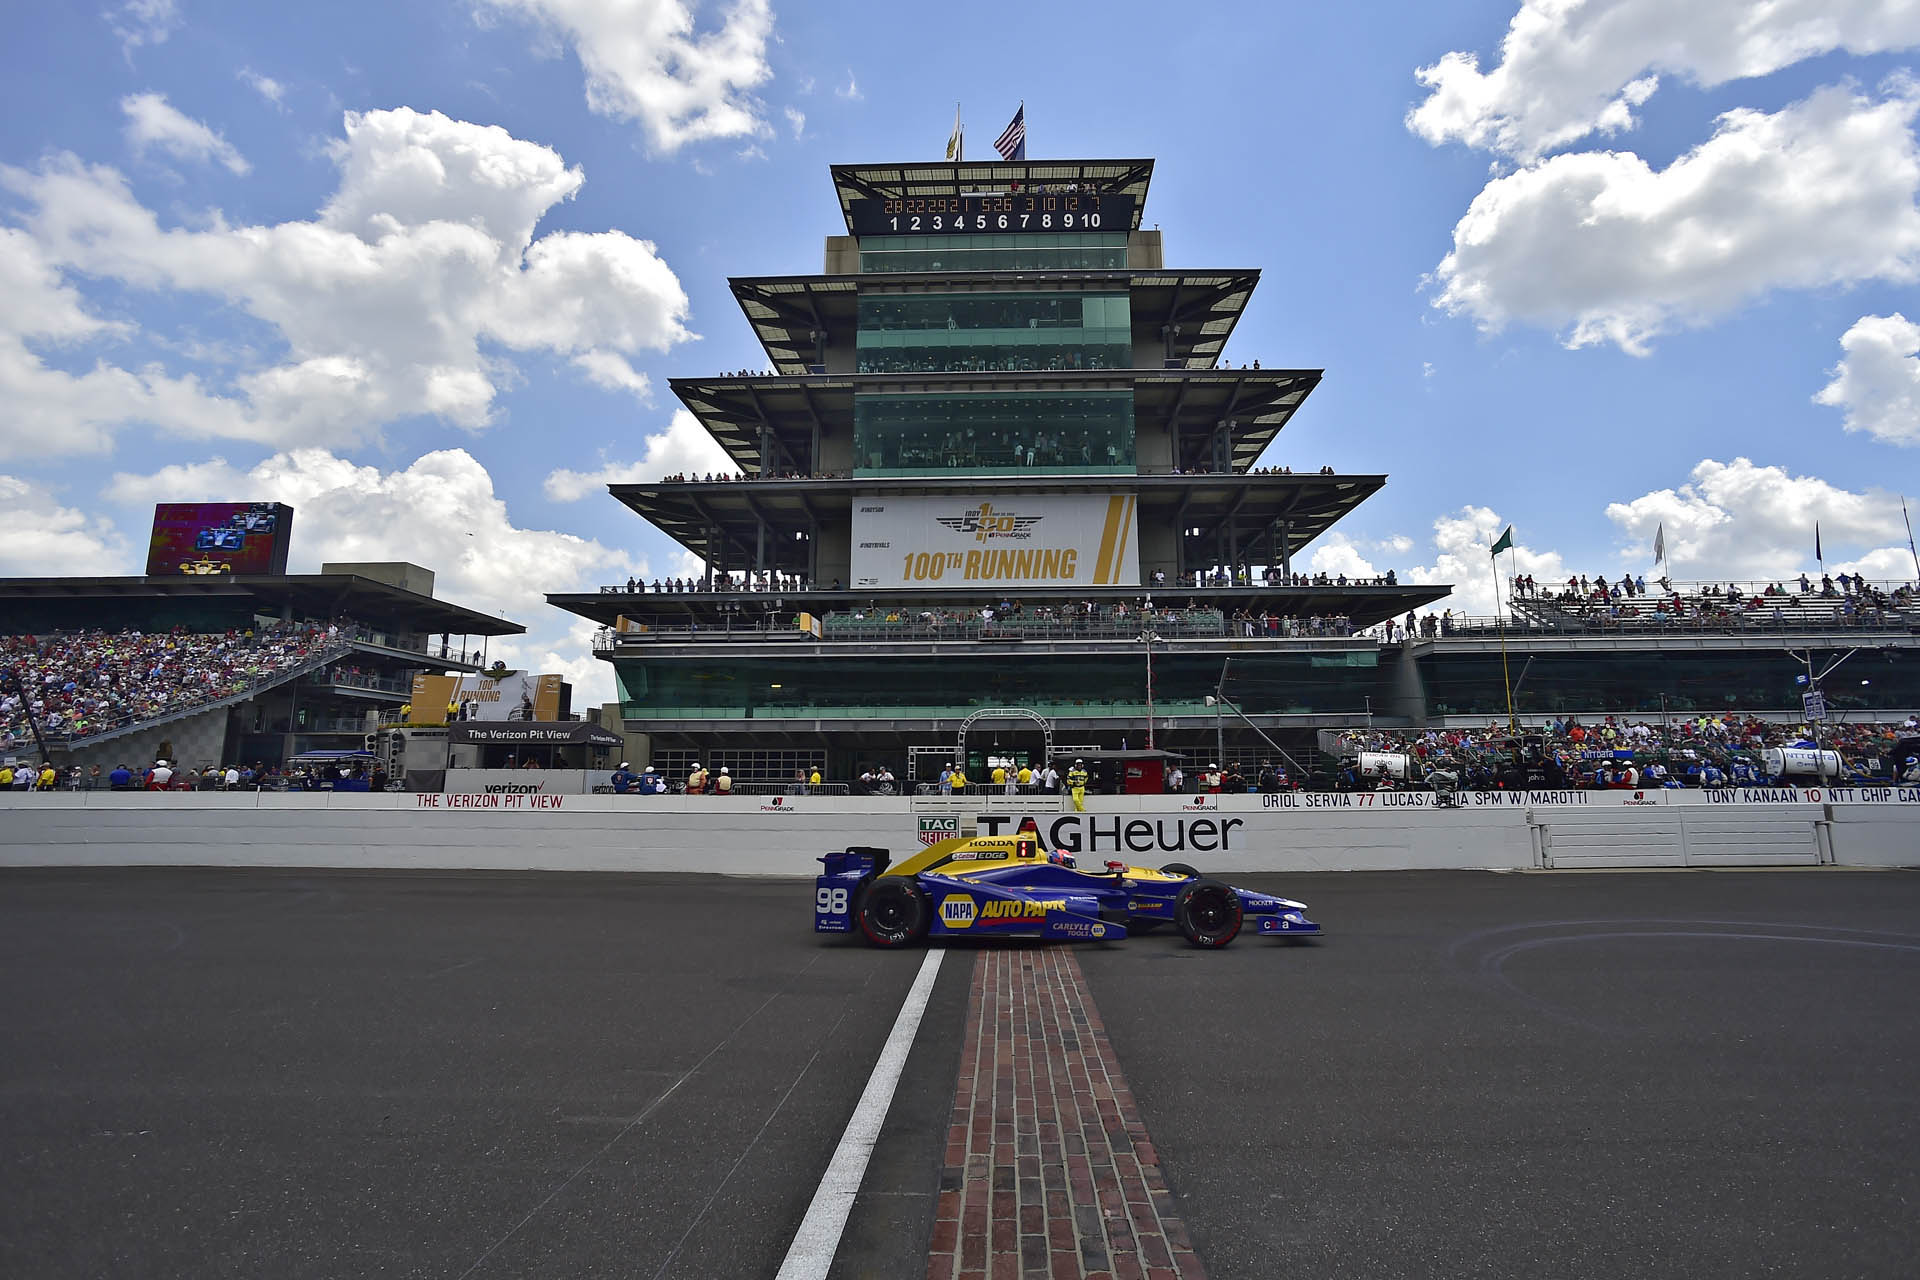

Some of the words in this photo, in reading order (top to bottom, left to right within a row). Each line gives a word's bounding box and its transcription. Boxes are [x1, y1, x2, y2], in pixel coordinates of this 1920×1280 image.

[907, 200, 925, 214] 22
[890, 216, 898, 230] 1
[910, 216, 921, 230] 2
[933, 216, 943, 230] 3
[954, 216, 965, 229] 4
[977, 215, 986, 229] 5
[998, 215, 1008, 228] 6
[1020, 215, 1030, 228] 7
[1042, 214, 1052, 228] 8
[1064, 214, 1074, 227] 9
[1081, 214, 1100, 227] 10
[903, 552, 963, 580] 100TH
[964, 549, 1077, 580] RUNNING
[459, 690, 501, 702] RUNNING
[468, 730, 487, 739] The
[489, 730, 527, 739] Verizon
[529, 730, 544, 739] Pit
[546, 730, 571, 739] View
[485, 782, 537, 794] verizon
[416, 794, 440, 807] THE
[446, 794, 499, 808] VERIZON
[504, 795, 524, 808] PIT
[530, 795, 564, 808] VIEW
[1263, 794, 1299, 807] ORIOL
[1306, 794, 1351, 807] SERVIA
[1357, 794, 1375, 806] 77
[1475, 792, 1501, 805] SPM
[1509, 791, 1587, 805] W/MAROTTI
[1704, 790, 1738, 803] TONY
[1744, 789, 1798, 803] KANAAN
[1803, 789, 1821, 802] 10
[1828, 789, 1854, 802] NTT
[1861, 789, 1891, 802] CHIP
[922, 820, 955, 829] TAG
[817, 888, 847, 914] 98
[945, 903, 973, 919] NAPA
[981, 901, 1022, 918] AUTO
[1024, 900, 1066, 917] PARTS
[1053, 923, 1090, 931] CARLYLE
